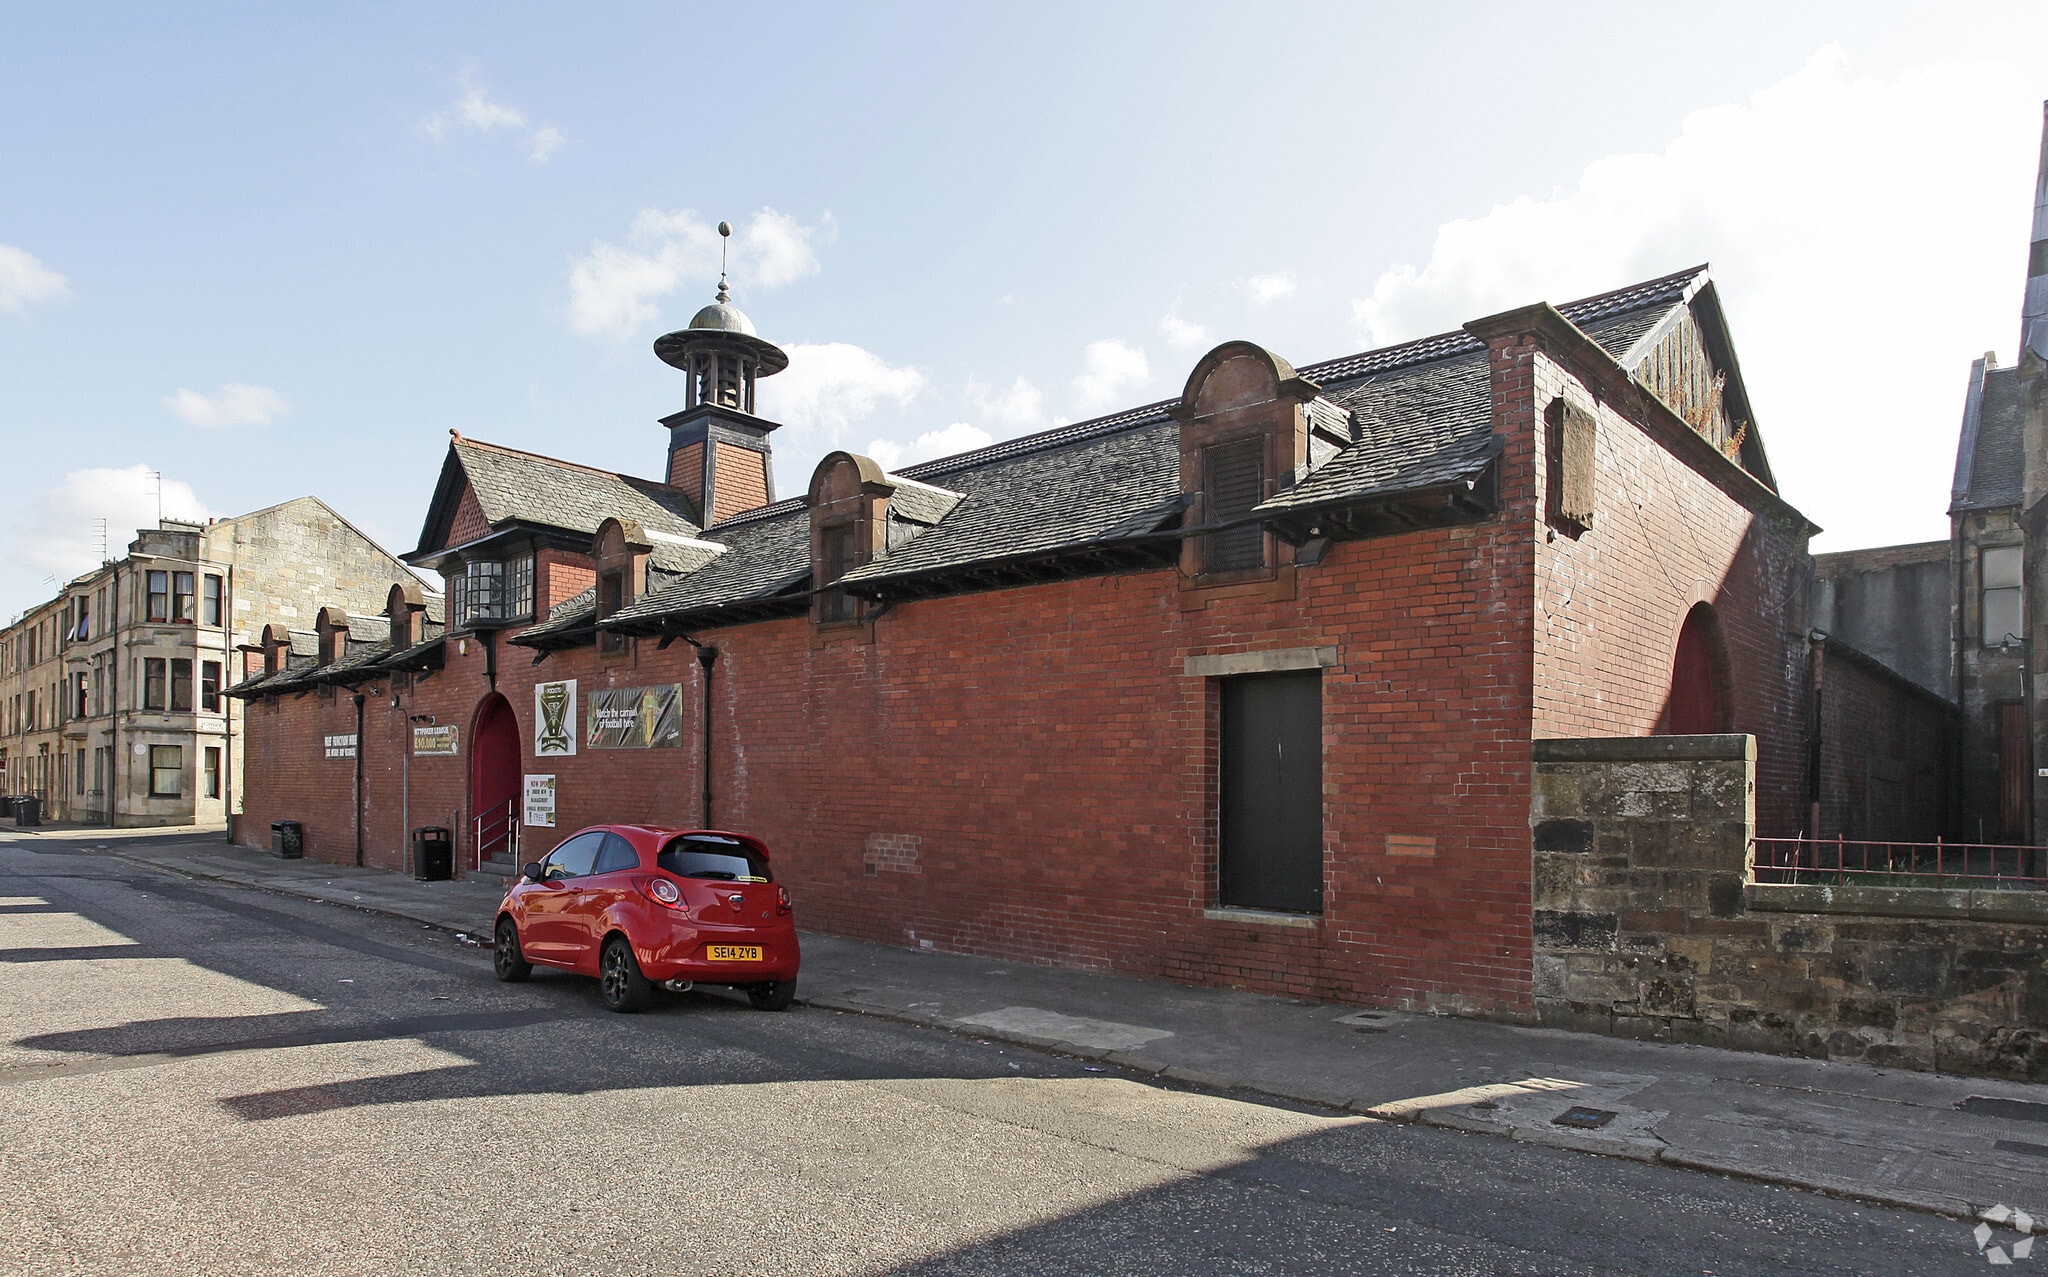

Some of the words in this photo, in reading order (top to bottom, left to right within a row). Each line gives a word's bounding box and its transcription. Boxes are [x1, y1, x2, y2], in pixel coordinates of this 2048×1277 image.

[596, 709, 610, 718] Watch
[599, 719, 605, 728] of
[605, 719, 622, 728] football
[623, 719, 634, 728] here
[414, 737, 436, 750] £10,000
[714, 947, 735, 958] SE14
[738, 947, 757, 958] ZYB
